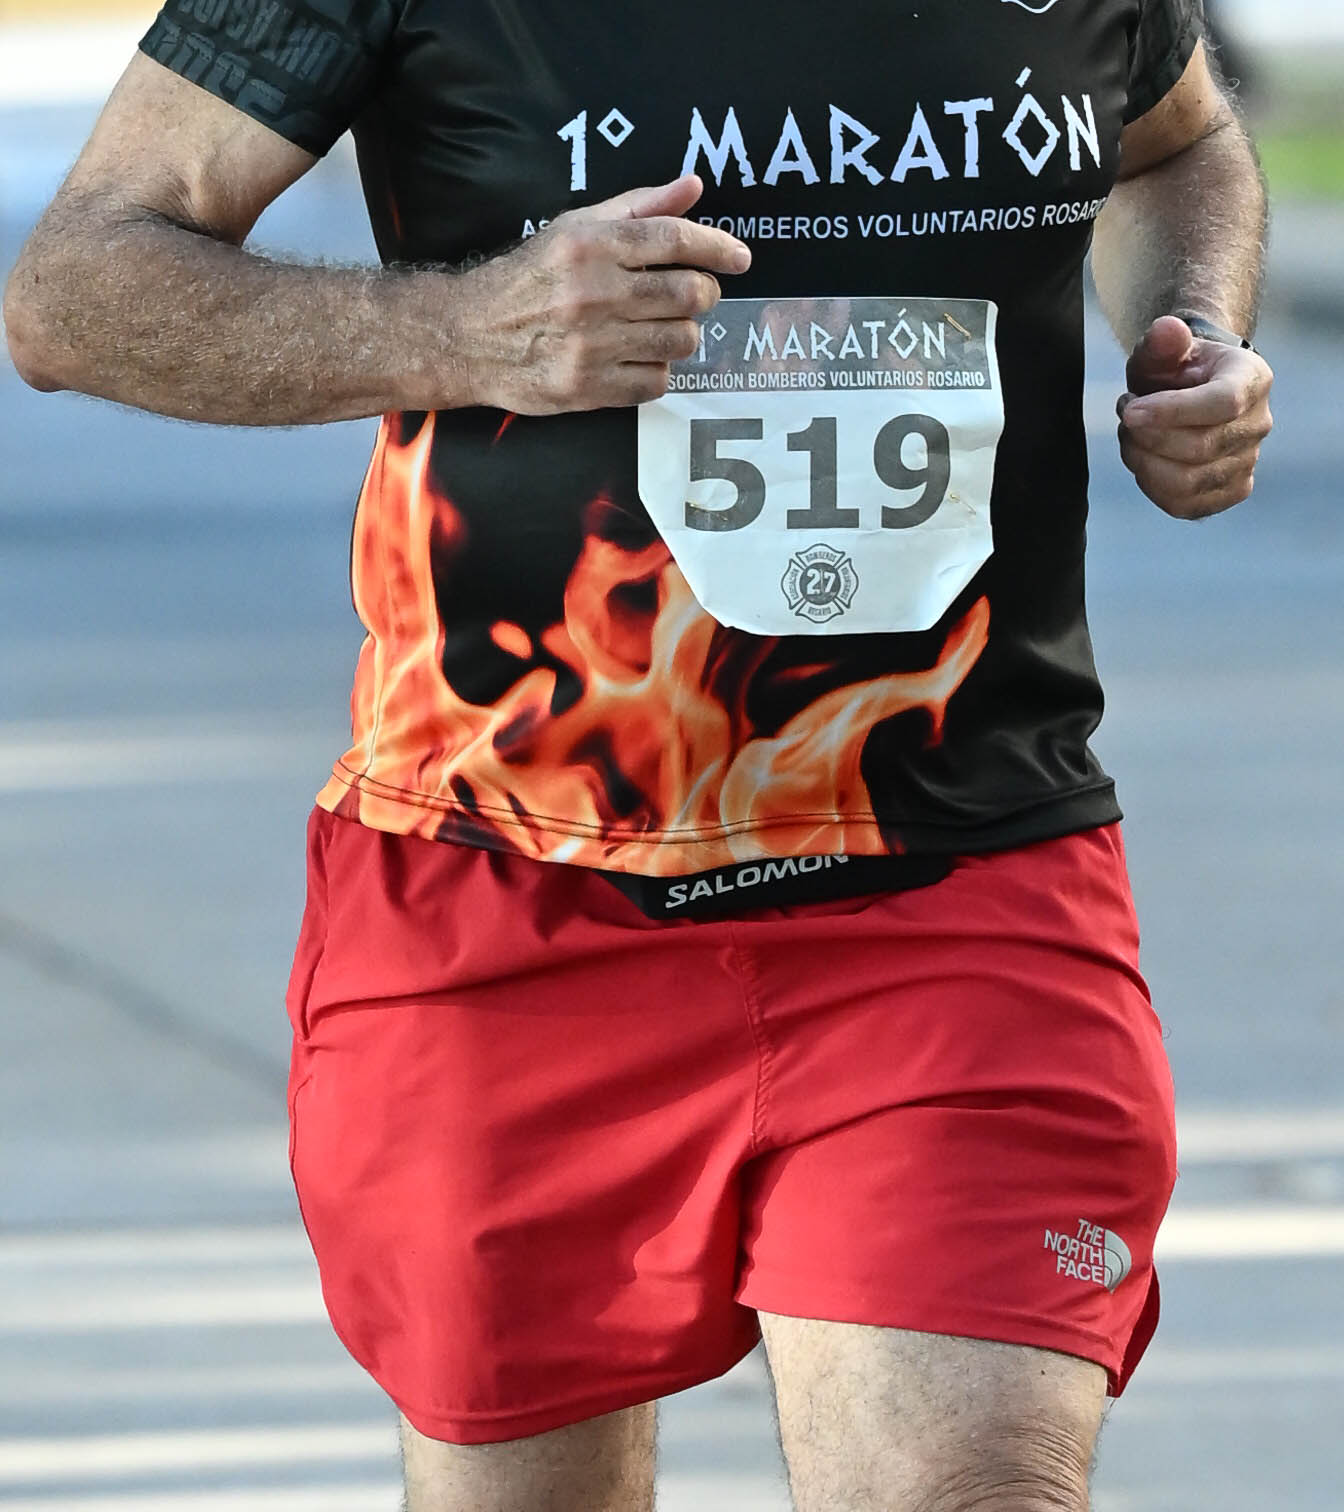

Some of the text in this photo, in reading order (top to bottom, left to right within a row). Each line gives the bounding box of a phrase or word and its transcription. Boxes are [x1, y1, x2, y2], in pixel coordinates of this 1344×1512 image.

[680, 66, 1101, 188] MARATÓN
[858, 205, 1036, 239] VOLUNTARIOS
[743, 307, 946, 362] MARATÓN
[667, 369, 986, 390] SOCIACIÓN BOMBEROS VOLUNTARIOS ROSARIO
[684, 413, 952, 532] 519
[806, 568, 837, 596] 27
[665, 855, 849, 909] SALOMON
[1043, 1228, 1104, 1266] NORTH
[1076, 1218, 1104, 1247] THE
[1056, 1255, 1104, 1285] FACE
